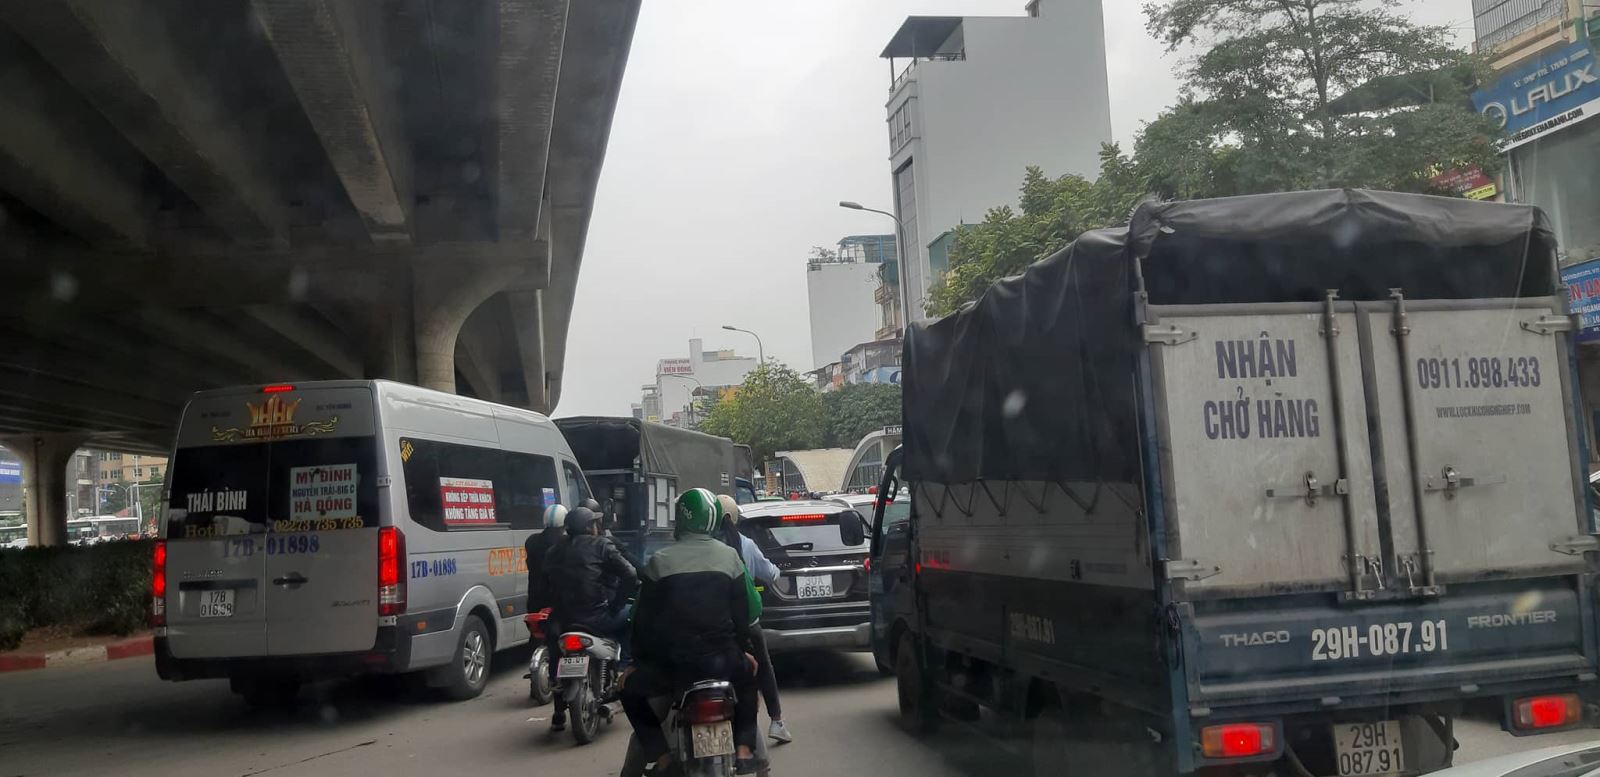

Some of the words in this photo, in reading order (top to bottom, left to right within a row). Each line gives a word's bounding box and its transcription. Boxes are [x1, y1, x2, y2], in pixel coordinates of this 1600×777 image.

[1511, 63, 1598, 117] LAUX
[1215, 331, 1297, 386] NHẬN
[1417, 357, 1541, 389] 0911.898.433
[1204, 386, 1250, 440] CHỞ
[1257, 392, 1320, 438] HÀNG
[187, 488, 213, 513] THÁI
[216, 486, 247, 511] BÌNH
[294, 497, 312, 513] HÀ
[316, 496, 352, 512] ĐÔNG
[445, 506, 464, 520] KHÔNG
[411, 558, 457, 579] 17B-01898
[210, 591, 226, 603] 17B
[1467, 609, 1556, 629] FRONTIER
[1219, 629, 1290, 648] THACO
[1311, 620, 1449, 661] 29H-087.91
[1350, 725, 1387, 748] 29H
[1339, 749, 1400, 775] 087.91
